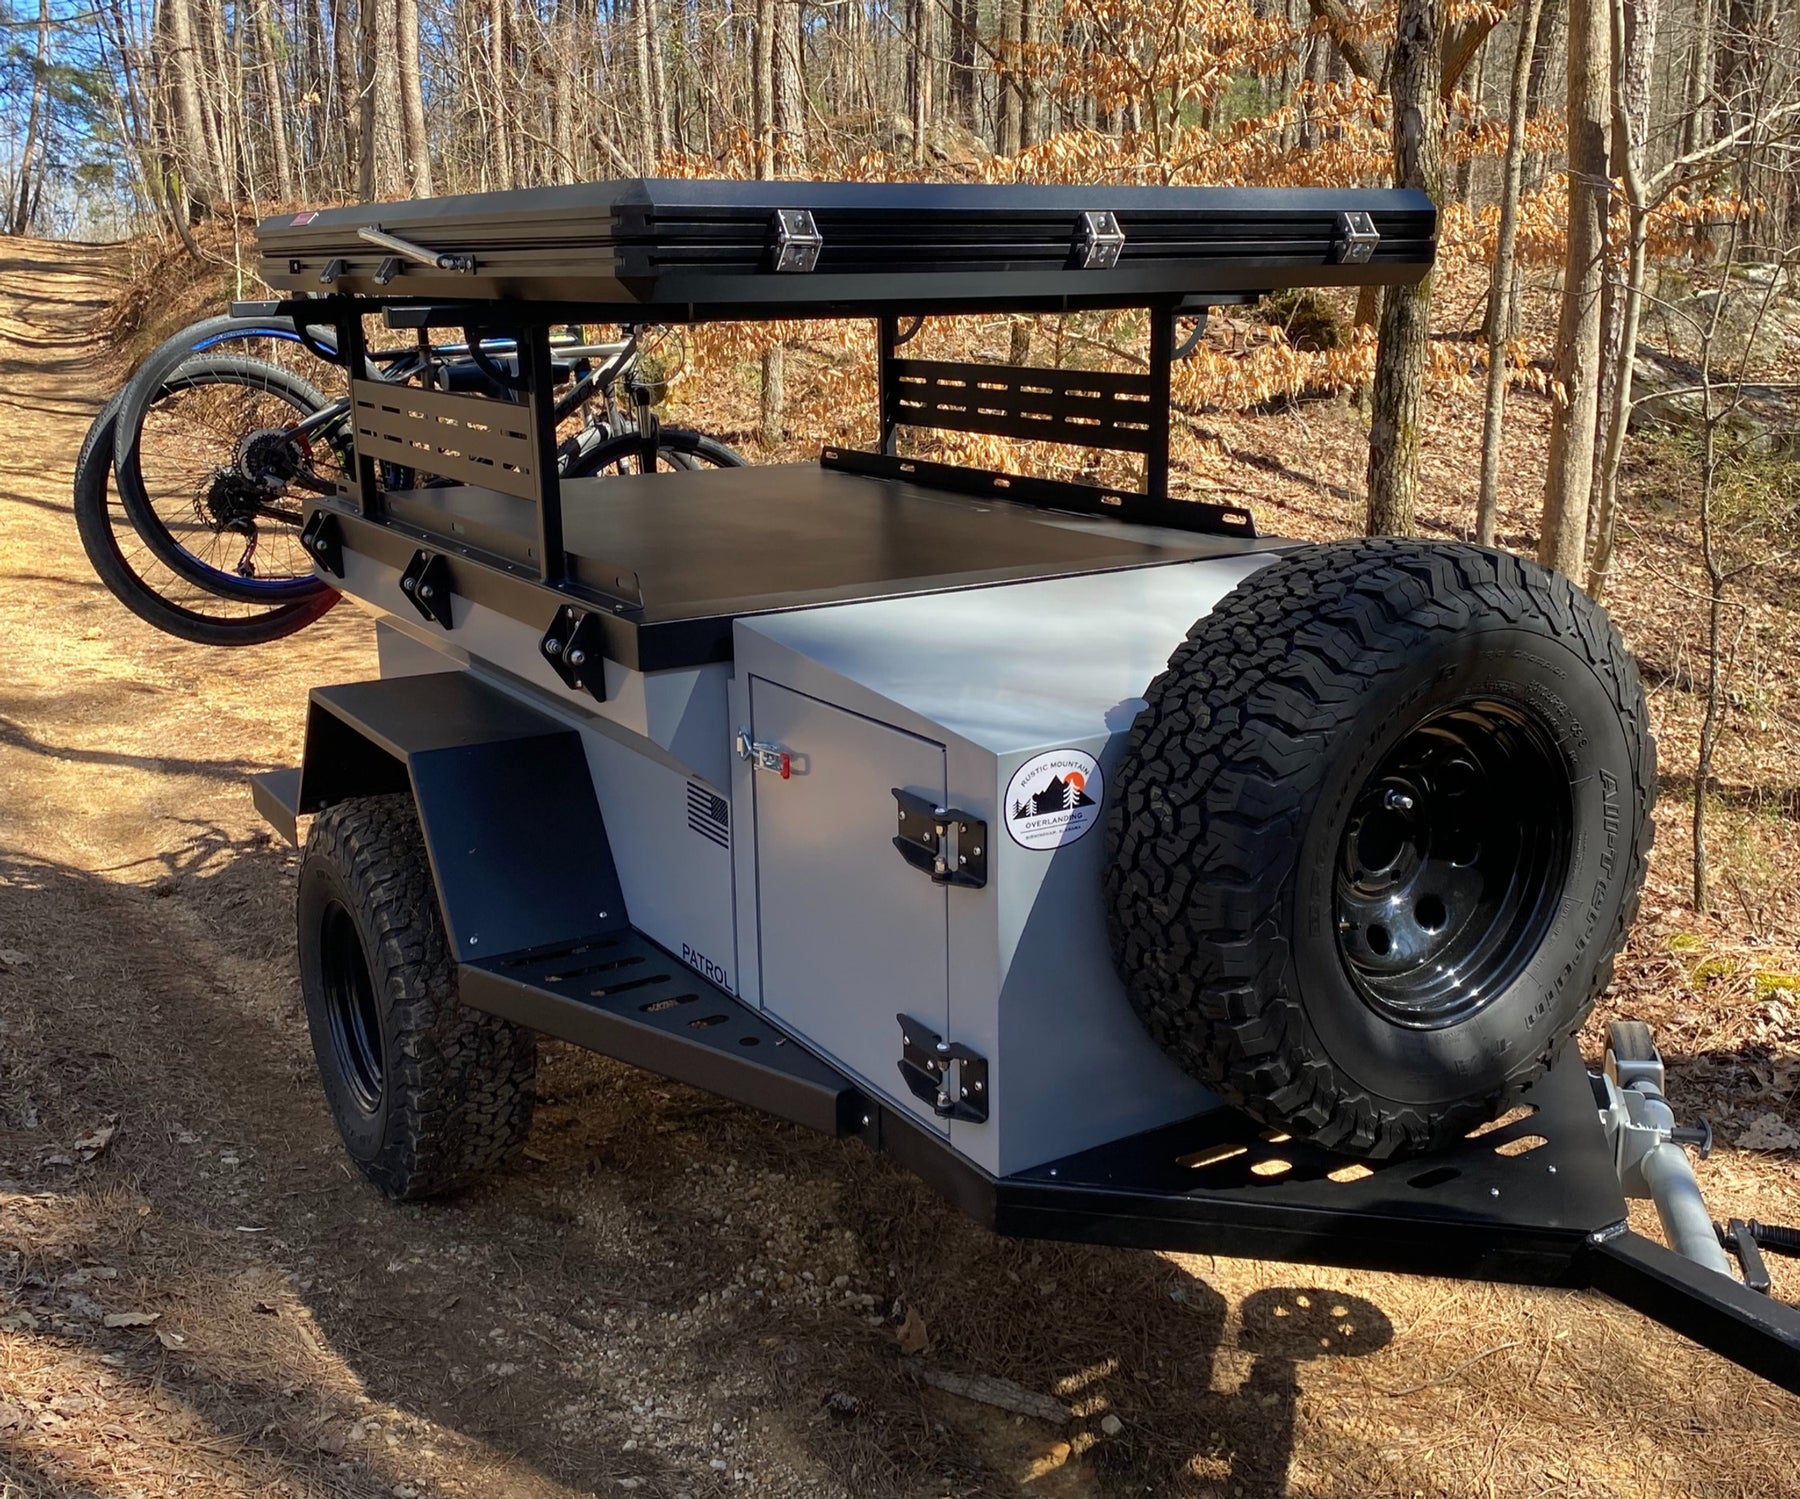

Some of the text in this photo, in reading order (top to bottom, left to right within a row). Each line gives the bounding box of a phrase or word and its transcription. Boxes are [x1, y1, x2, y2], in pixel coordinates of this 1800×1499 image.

[1020, 760, 1090, 788] RUSTIC MOUNTAIN
[1025, 811, 1084, 829] OVERLANDING
[682, 942, 734, 992] PATROL
